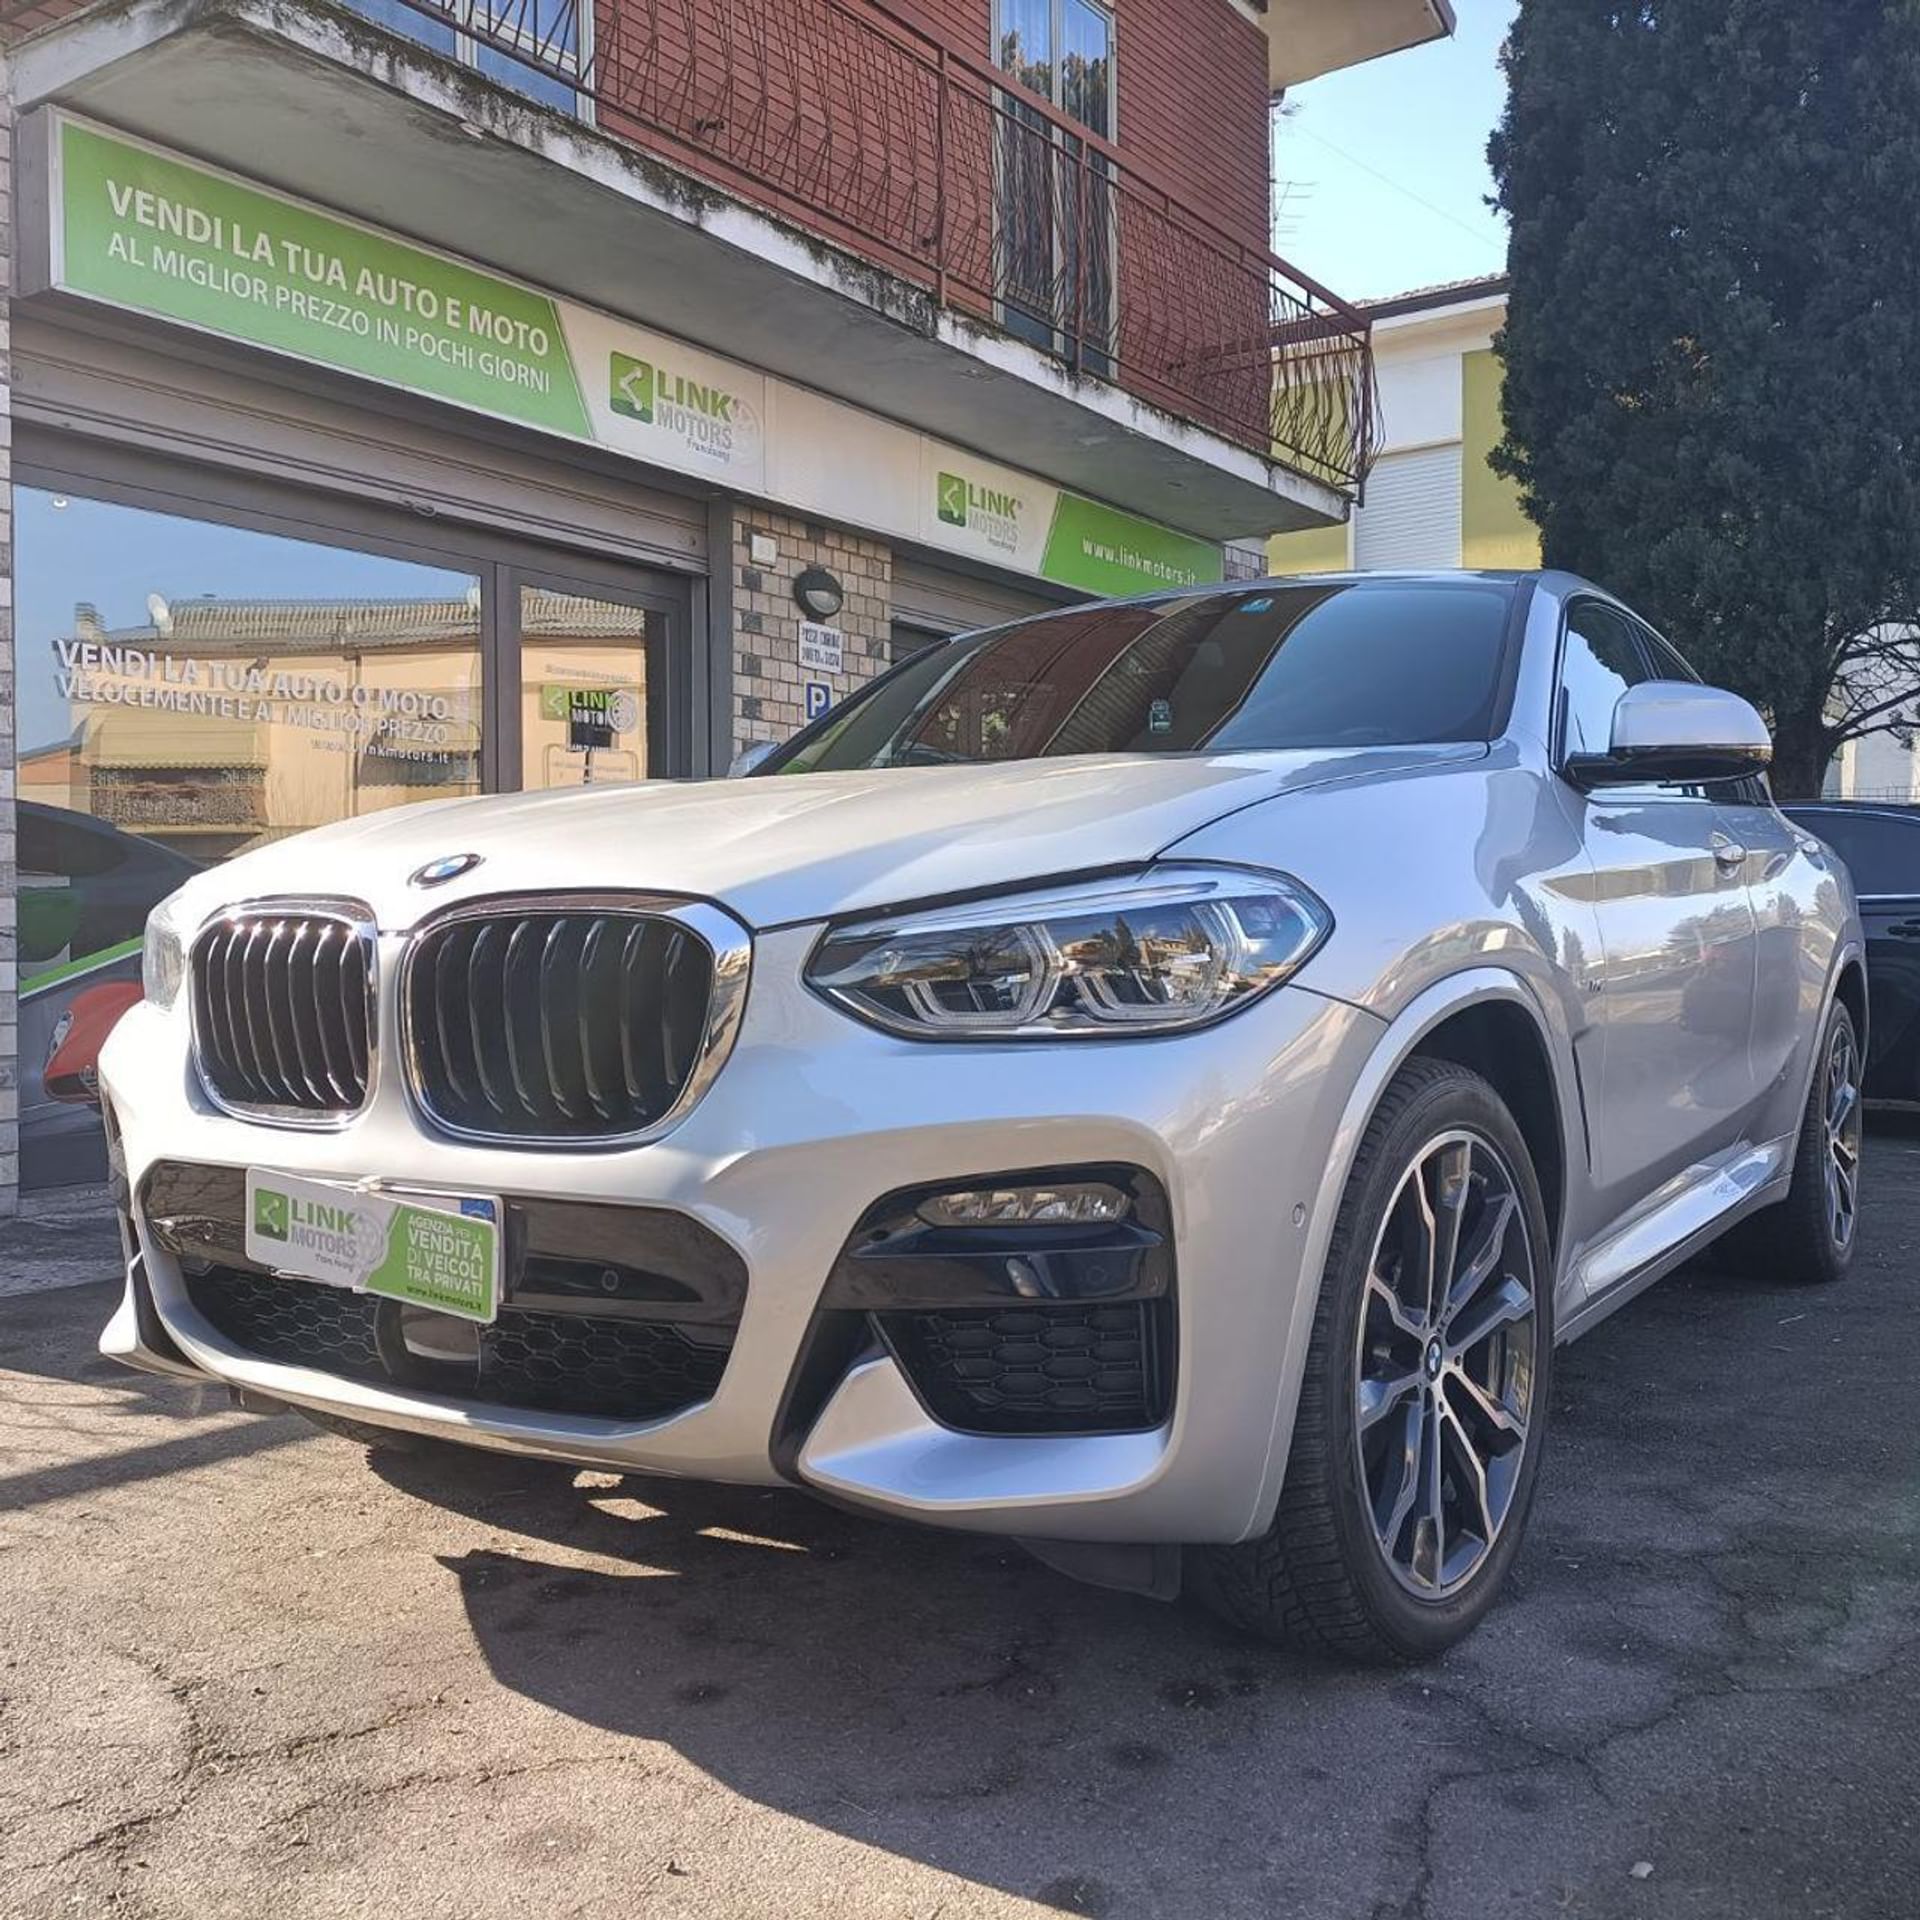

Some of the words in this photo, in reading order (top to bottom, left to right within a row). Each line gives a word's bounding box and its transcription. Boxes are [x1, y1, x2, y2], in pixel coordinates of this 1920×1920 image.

[106, 179, 222, 250] VENDI
[232, 223, 275, 267] LA
[281, 239, 348, 291] TUA
[355, 267, 438, 319] AUTO
[446, 296, 461, 328] E
[469, 305, 548, 357] MOTO
[107, 232, 145, 267] AL
[153, 245, 268, 306] MIGLIOR
[275, 285, 369, 336] PREZZO
[376, 317, 399, 346] IN
[406, 327, 473, 369] POCHI
[479, 352, 549, 393] GIORNI
[657, 369, 732, 423] LINK
[657, 402, 732, 450] MOTORS
[969, 483, 1017, 520] LINK
[1082, 538, 1196, 586] www.linkmotors.it
[55, 638, 156, 679] VENDI
[164, 655, 199, 685] LA
[208, 659, 263, 694] TUA
[274, 672, 344, 704] AUTO
[352, 684, 369, 706] O
[378, 688, 448, 719] MOTO
[59, 673, 233, 718] VELOCEMENTE
[377, 717, 447, 744] PREZZO
[810, 686, 827, 717] P
[290, 1198, 355, 1235] LINK
[408, 1214, 454, 1236] AGENZIA
[291, 1225, 356, 1259] MOTORS
[408, 1227, 483, 1262] VENDITA
[406, 1264, 432, 1284] TRA
[434, 1271, 483, 1297] PRIVATI
[407, 1246, 421, 1264] DI
[424, 1250, 483, 1280] VEICOLI
